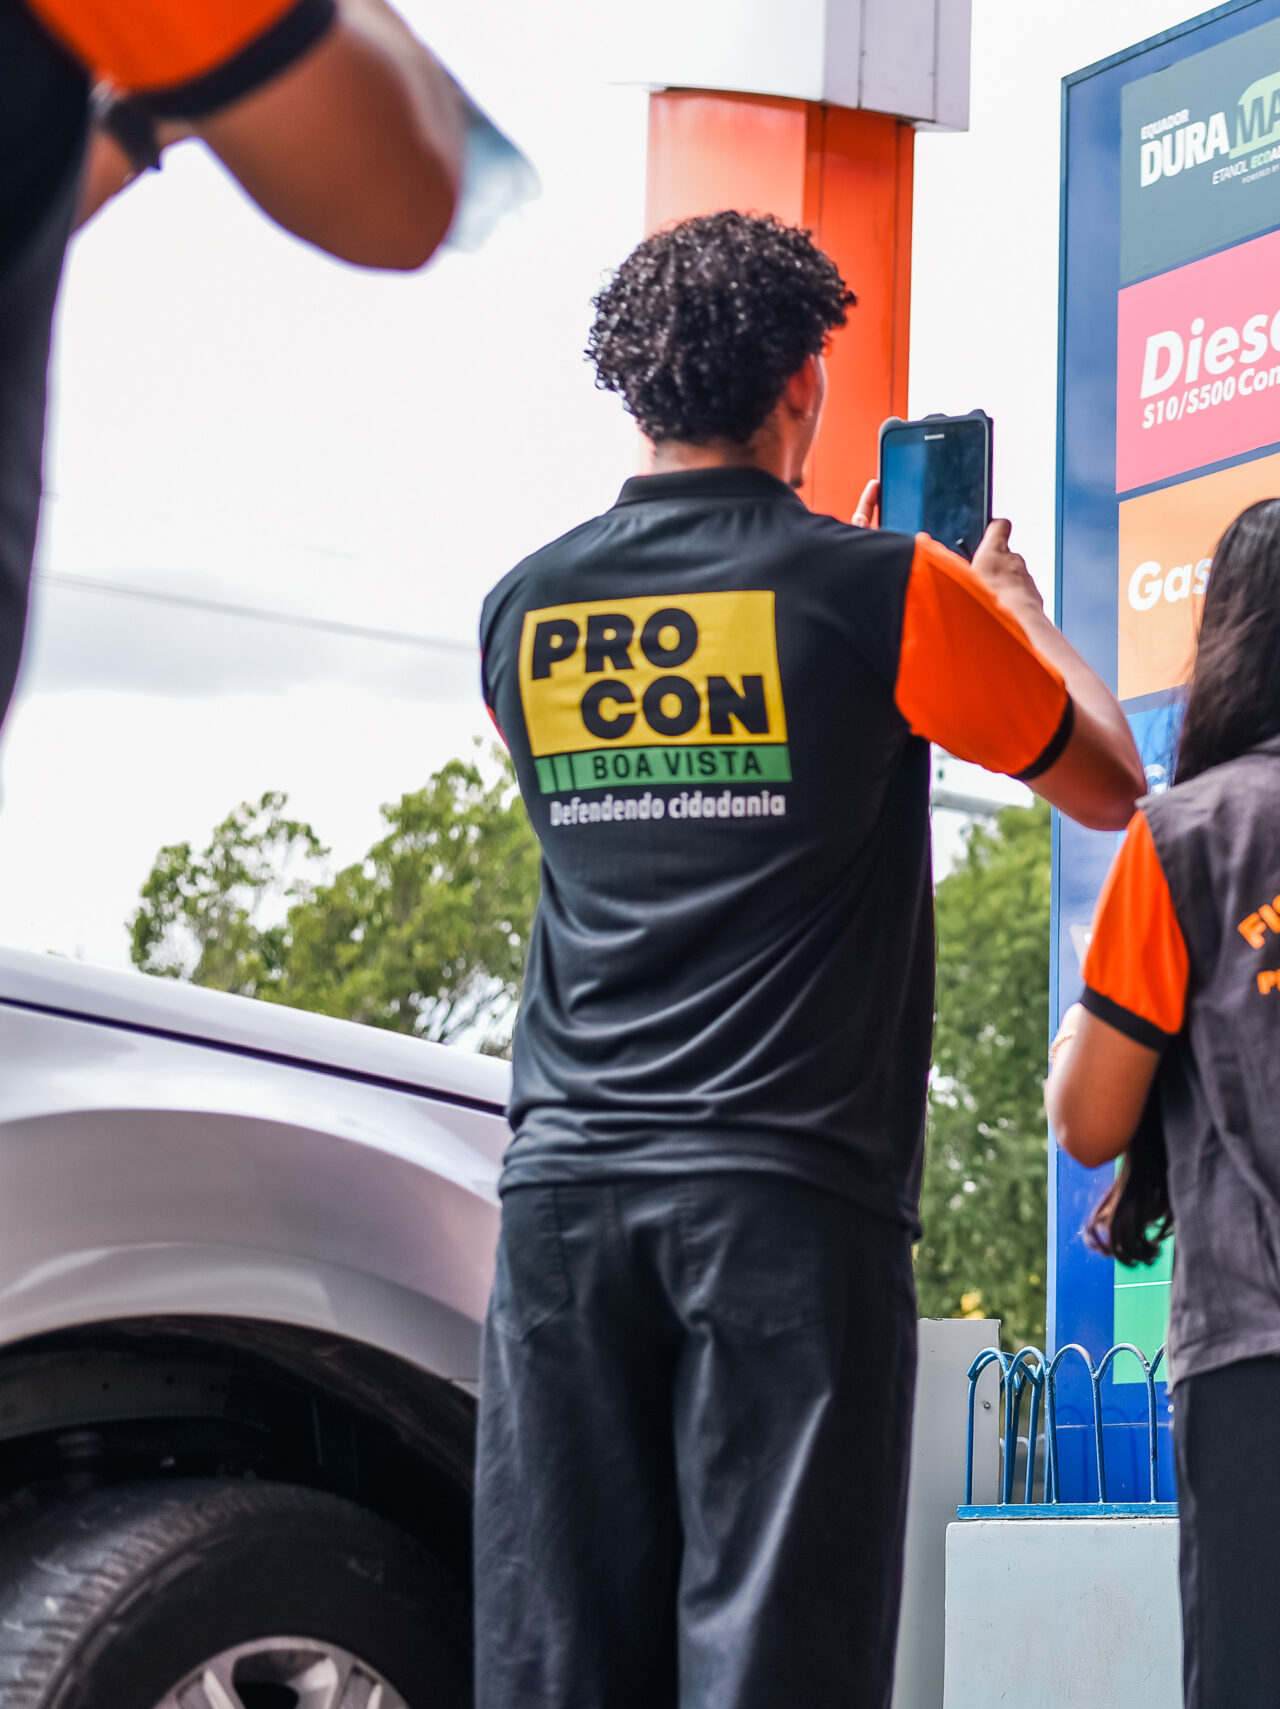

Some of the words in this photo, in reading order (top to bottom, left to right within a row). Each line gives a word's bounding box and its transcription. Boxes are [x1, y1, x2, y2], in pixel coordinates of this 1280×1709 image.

[1140, 111, 1230, 188] DURA
[1141, 109, 1190, 140] EQUADOR
[1212, 159, 1249, 185] ETANOL
[1142, 375, 1236, 429] S10/S500
[1128, 558, 1213, 612] Gas
[532, 607, 699, 681] PRO
[581, 673, 770, 740] CON
[593, 754, 653, 780] BOA
[664, 750, 763, 776] VISTA
[550, 792, 665, 826] Defendendo
[668, 789, 786, 819] cidadania
